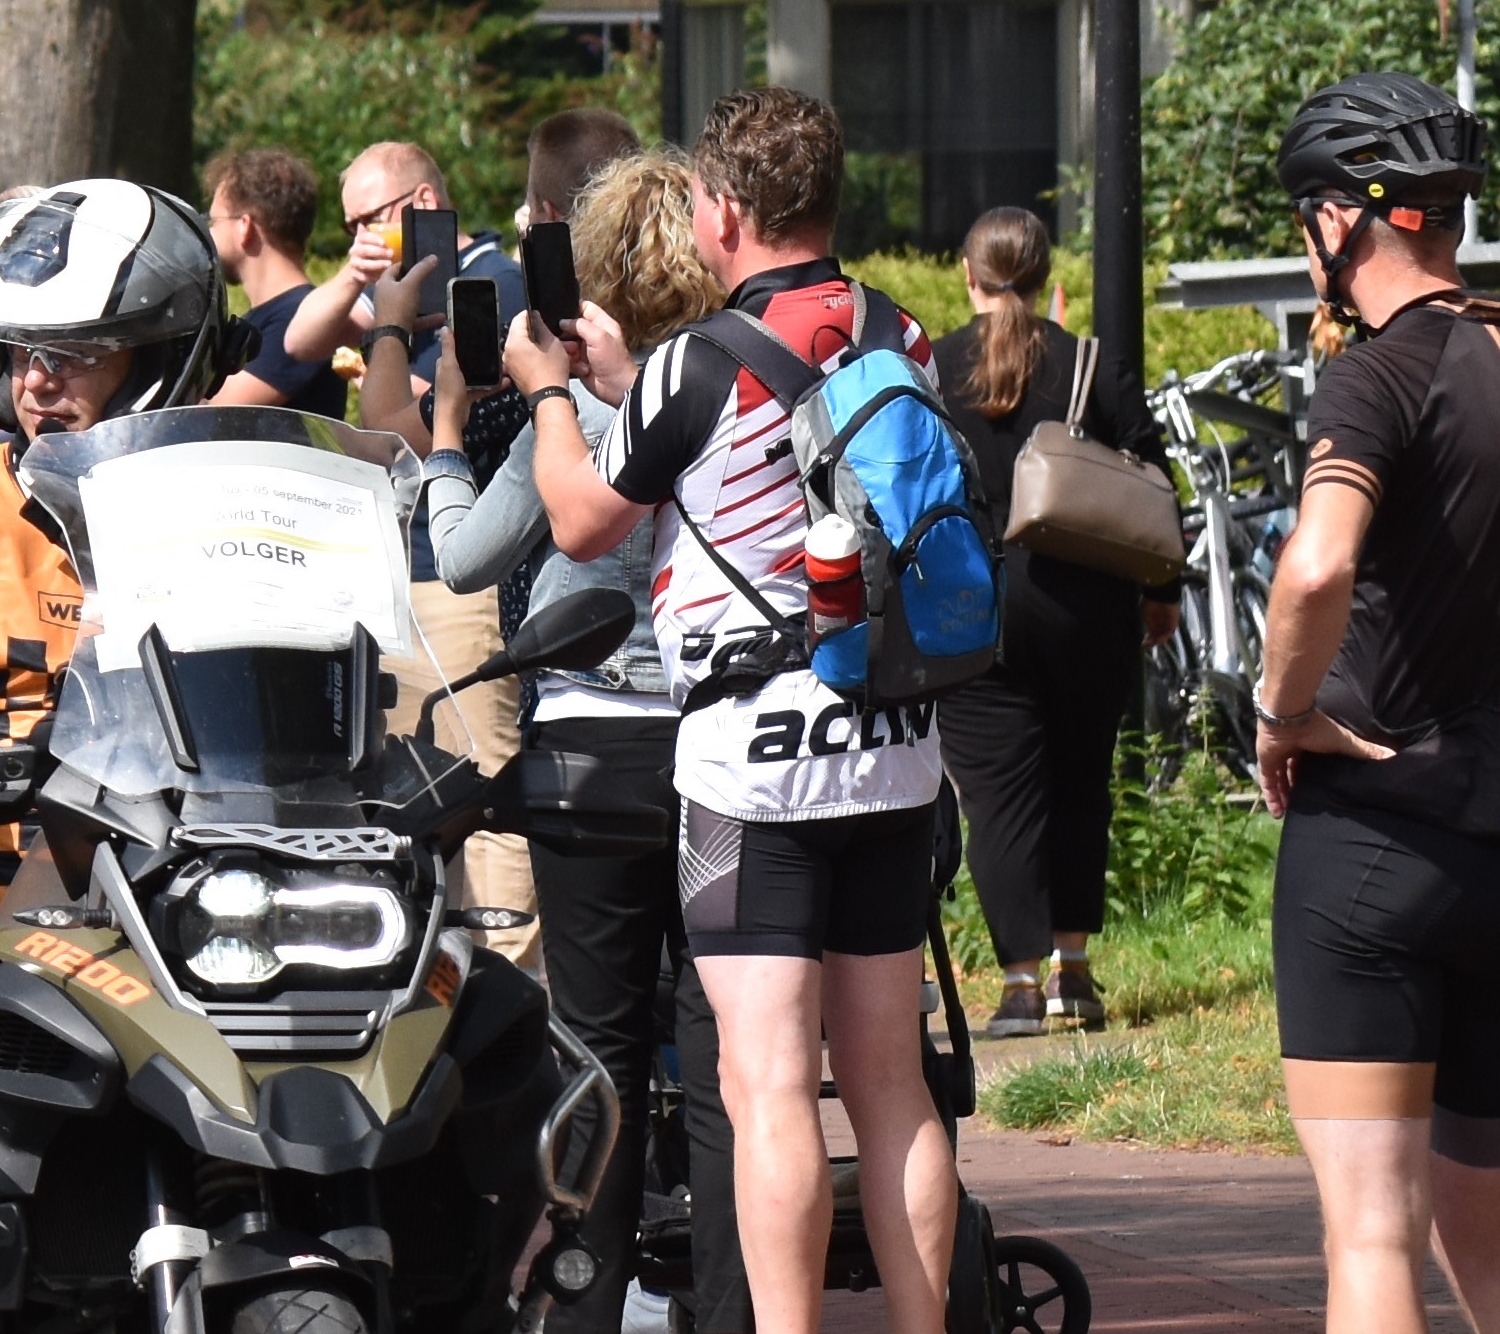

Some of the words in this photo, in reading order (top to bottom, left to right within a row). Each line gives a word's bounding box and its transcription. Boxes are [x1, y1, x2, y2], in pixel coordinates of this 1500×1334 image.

[273, 489, 332, 510] september
[260, 509, 298, 530] Tour
[201, 541, 307, 568] VOLGER
[13, 929, 151, 1007] R1200
